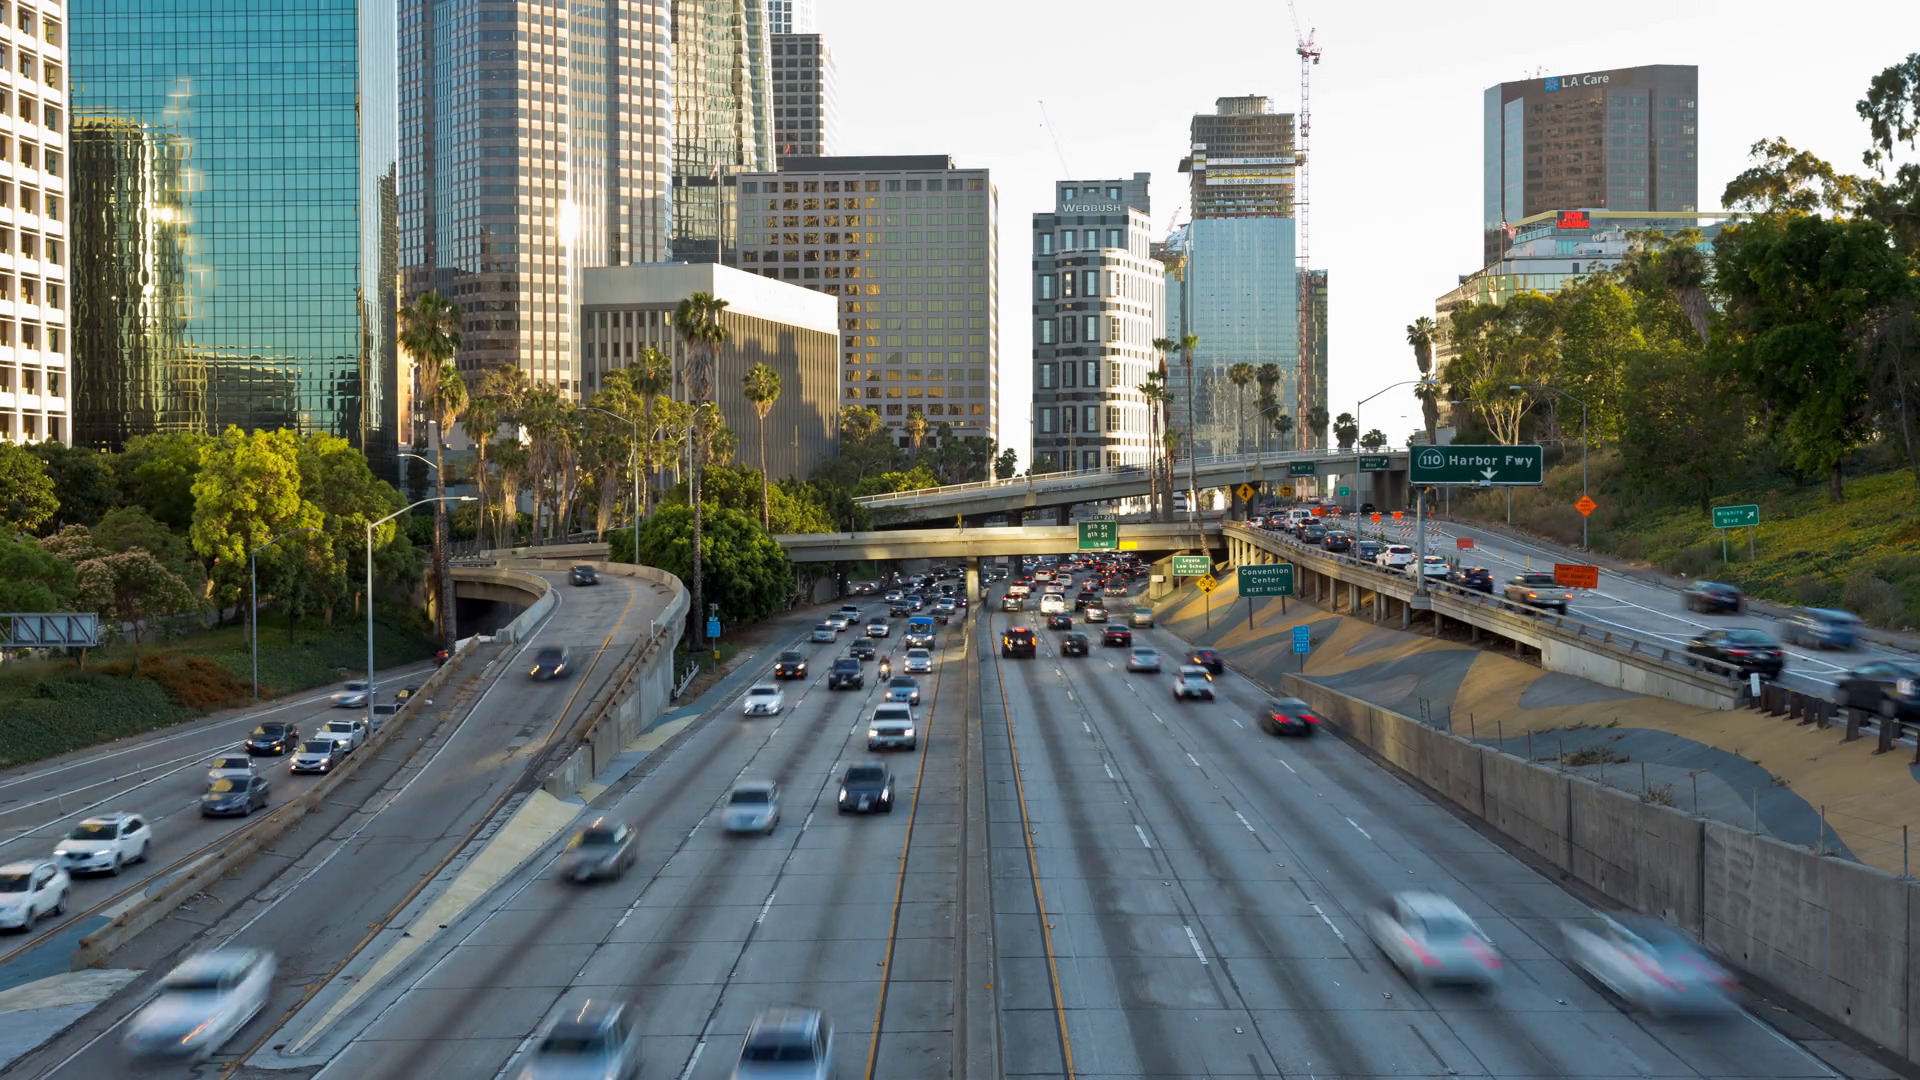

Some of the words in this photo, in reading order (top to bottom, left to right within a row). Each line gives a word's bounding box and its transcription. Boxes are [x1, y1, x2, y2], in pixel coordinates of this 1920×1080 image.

[1561, 76, 1581, 88] L.A.
[1583, 75, 1610, 86] Care
[1423, 455, 1441, 465] 110
[1449, 455, 1498, 466] Harbor
[1505, 455, 1533, 468] Fwy
[1241, 568, 1289, 576] Convention
